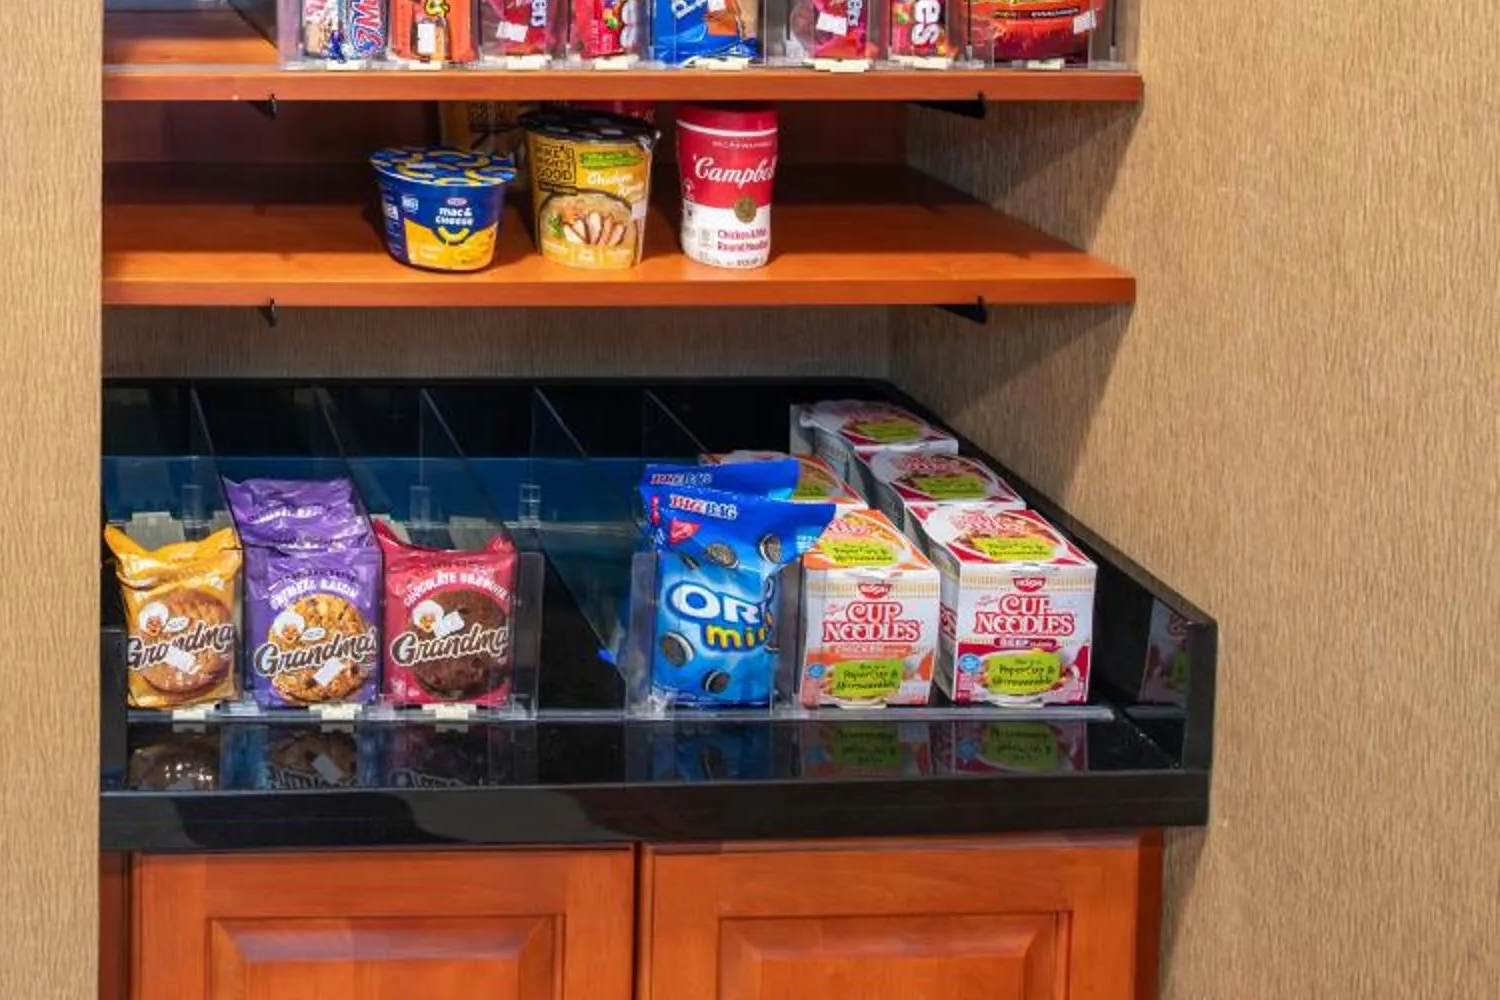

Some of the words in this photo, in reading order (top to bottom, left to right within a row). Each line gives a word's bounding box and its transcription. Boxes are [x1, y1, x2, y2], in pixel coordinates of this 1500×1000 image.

[845, 601, 903, 622] CUP
[999, 593, 1051, 616] CUP
[822, 619, 921, 643] NOODLES
[973, 611, 1076, 636] NOODLES
